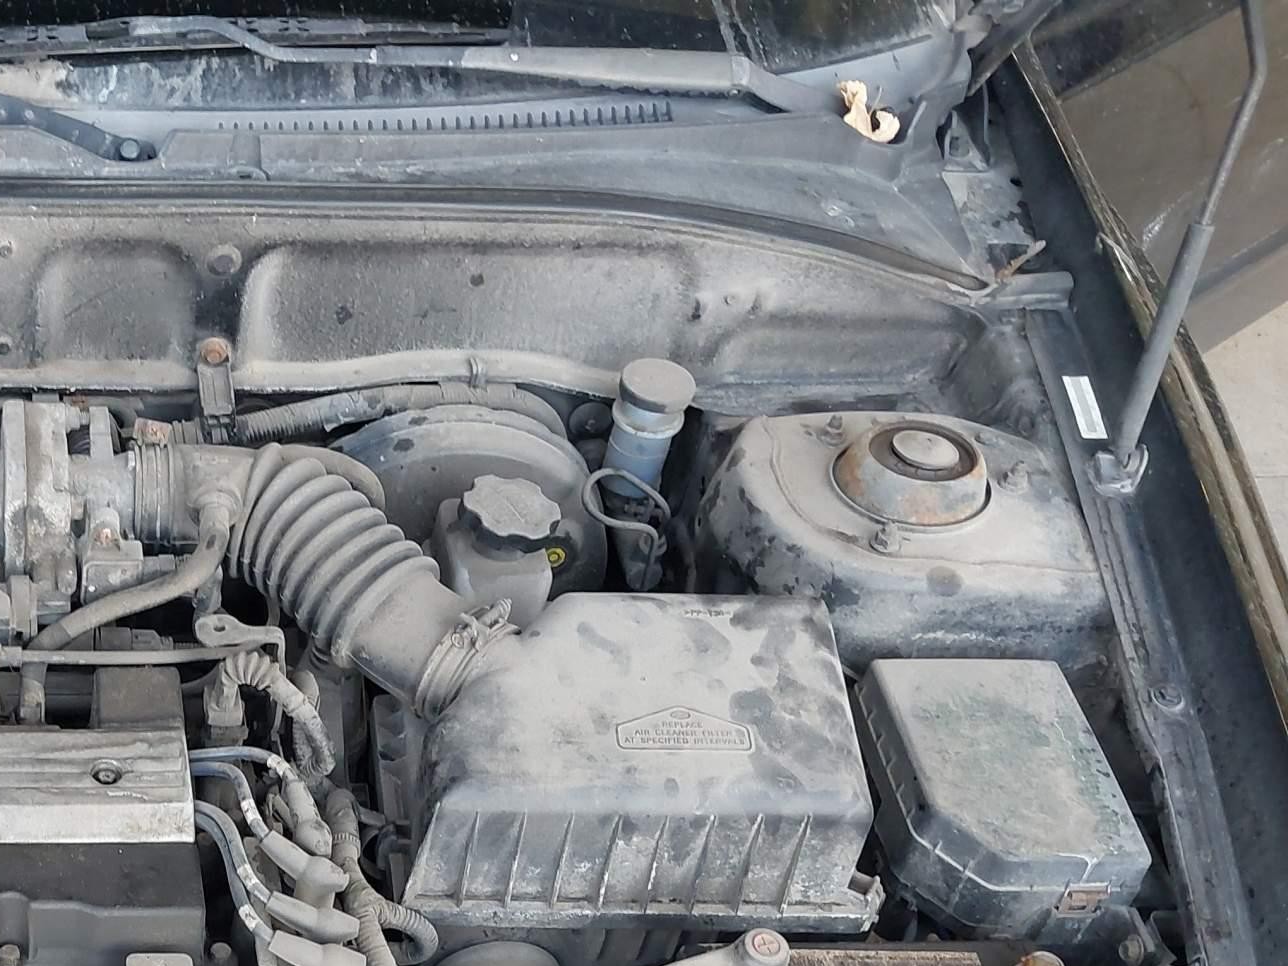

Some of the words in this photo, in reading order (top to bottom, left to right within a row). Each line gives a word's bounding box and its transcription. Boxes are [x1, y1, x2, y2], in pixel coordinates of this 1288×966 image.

[662, 720, 704, 729] REPLACE
[634, 729, 650, 737] AIR
[655, 729, 699, 737] CLEANER
[624, 736, 635, 744] AT
[640, 736, 689, 745] SPECIFIED
[693, 737, 745, 745] INTERVALS
